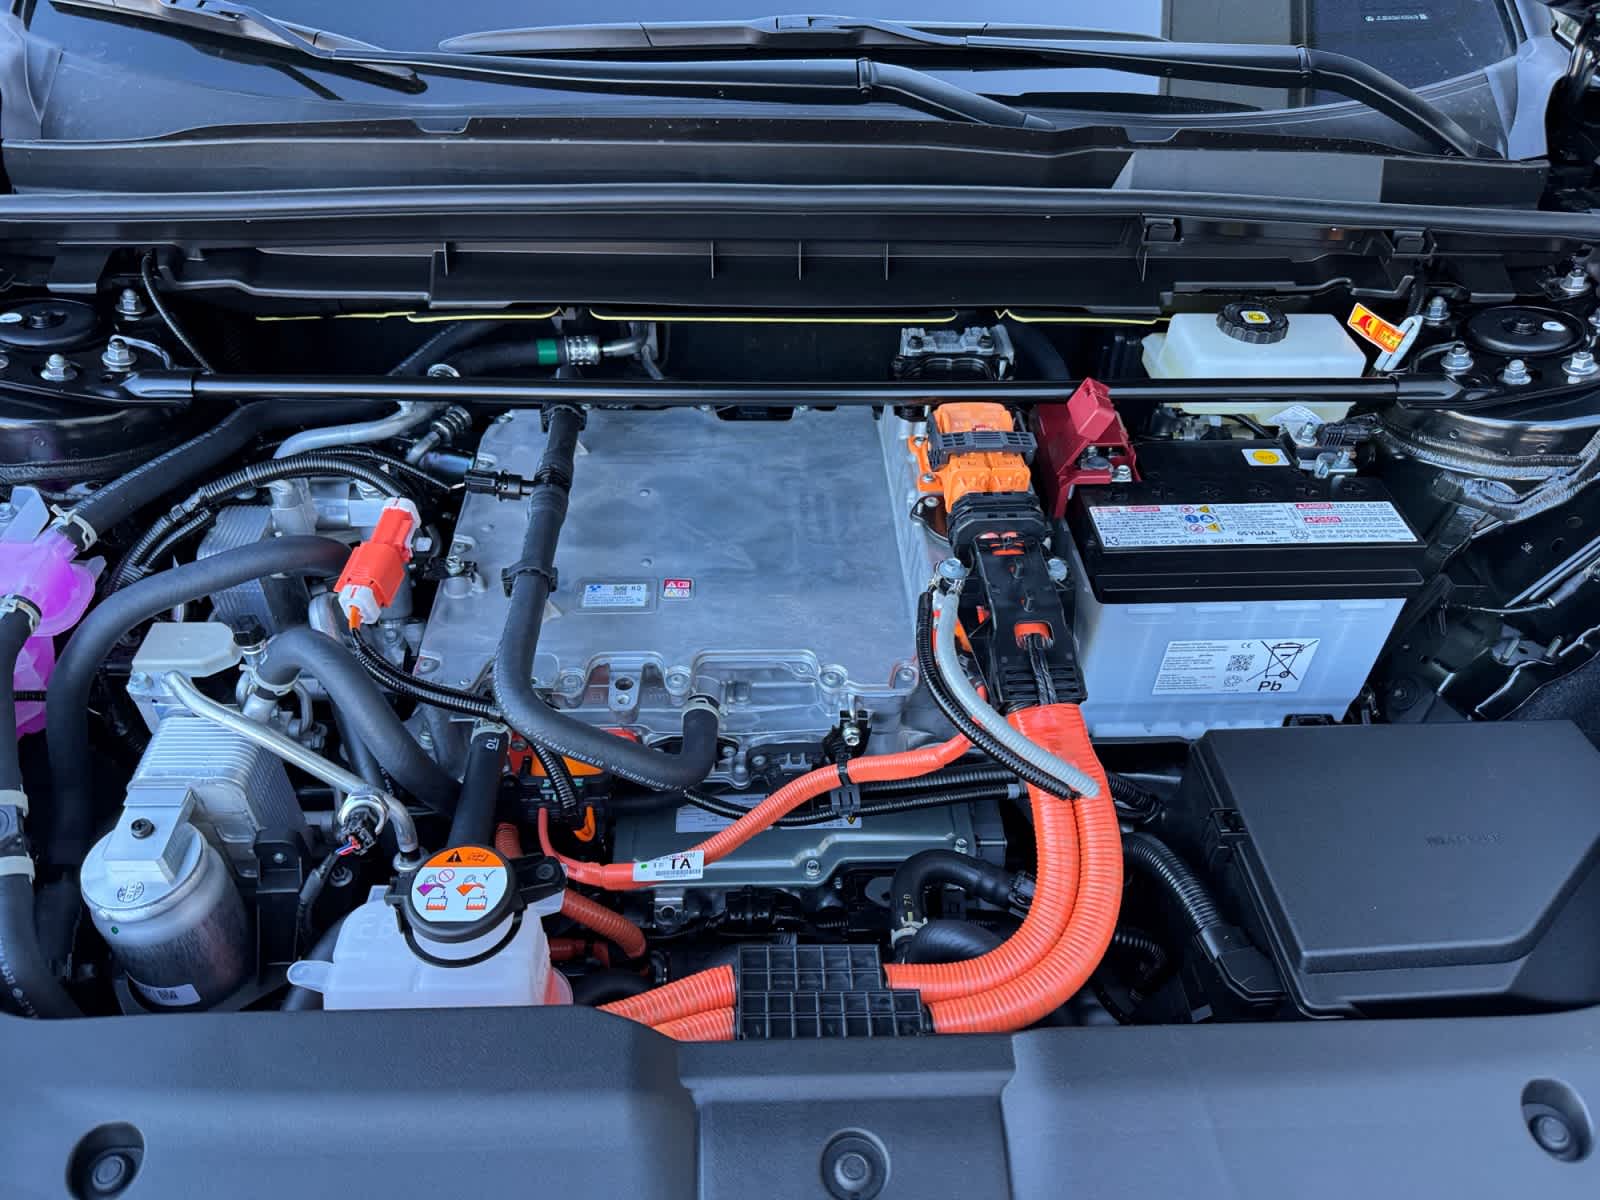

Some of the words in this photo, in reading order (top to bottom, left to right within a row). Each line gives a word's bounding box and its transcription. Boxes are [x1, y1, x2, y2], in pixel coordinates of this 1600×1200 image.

[1105, 536, 1119, 546] A3
[1257, 680, 1282, 692] Pb
[672, 858, 691, 869] TA
